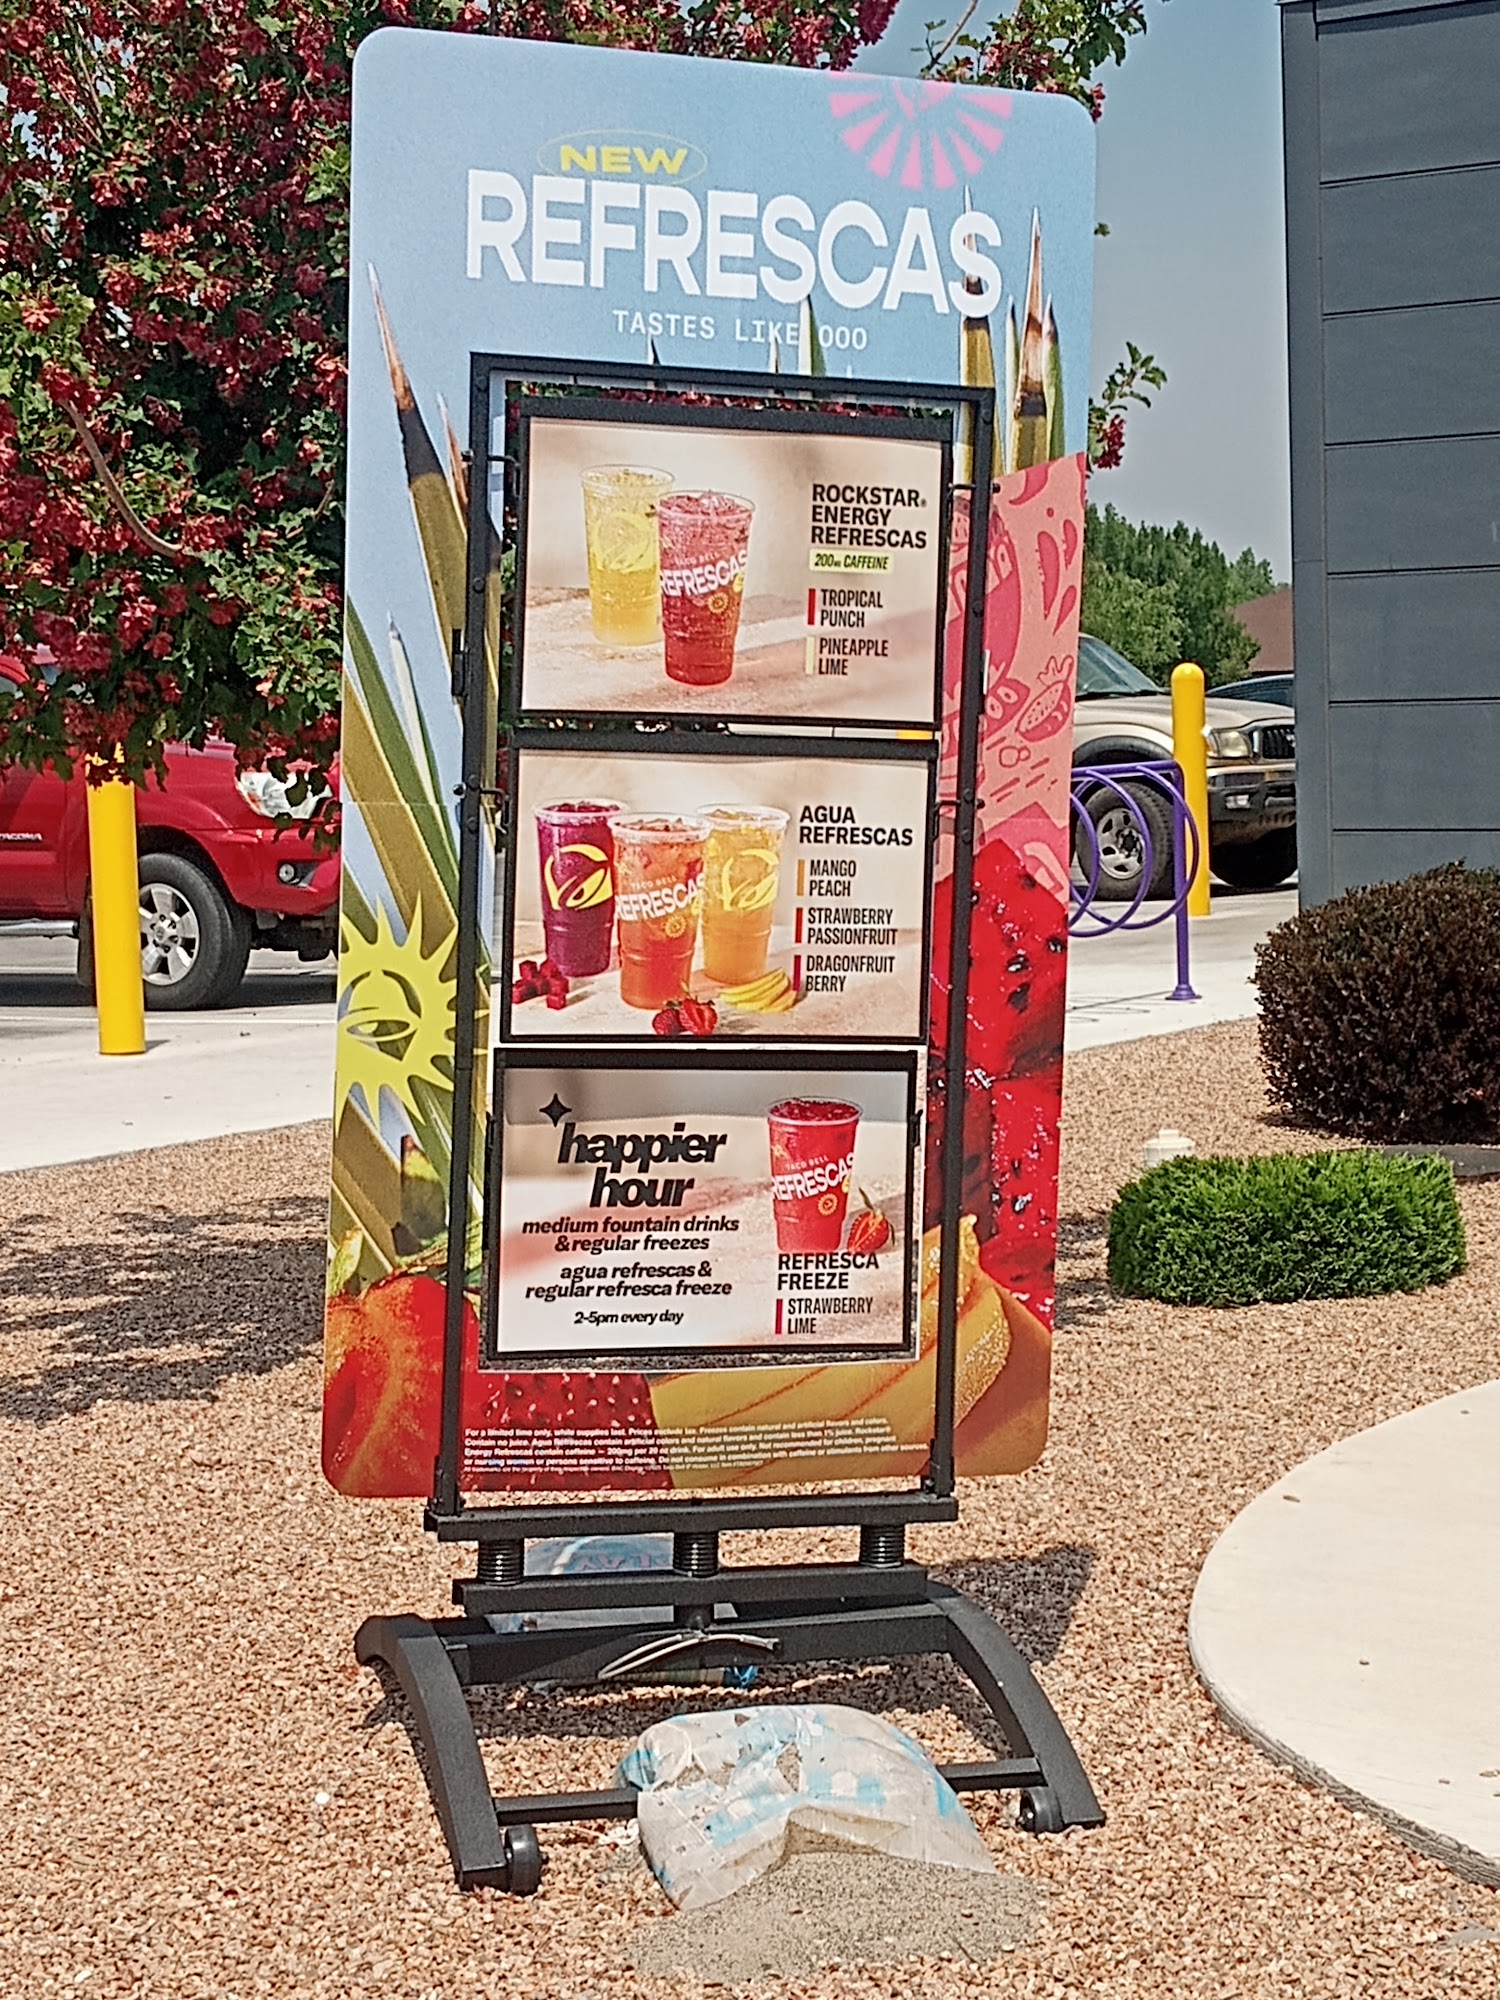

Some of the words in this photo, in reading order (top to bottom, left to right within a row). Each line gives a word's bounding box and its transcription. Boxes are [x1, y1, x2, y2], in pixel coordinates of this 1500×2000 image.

[560, 144, 689, 176] NEW
[466, 169, 1003, 318] REFRESCAS
[613, 310, 715, 340] TASTES
[734, 319, 799, 346] LIKE
[812, 506, 891, 527] ENERGY
[811, 527, 927, 549] REFRESCAS
[844, 555, 889, 570] CAFFEINE
[822, 589, 883, 609] TROPICAL
[821, 610, 865, 628] PUNCH
[819, 638, 888, 657] PINEAPPLE
[819, 659, 848, 676] LIME
[800, 805, 856, 824] AGUA
[800, 826, 913, 847] REFRESCAS
[810, 859, 856, 878] MANGO
[809, 880, 851, 897] PEACH
[808, 908, 893, 925] STRAWBERRY
[807, 928, 898, 946] PASSIONFRUIT
[806, 955, 896, 974] DRAGONFRUIT
[806, 975, 847, 993] BERRY
[558, 1123, 727, 1174] happier
[590, 1167, 695, 1208] hour
[522, 1218, 598, 1234] medium
[602, 1216, 680, 1233] fountain
[683, 1216, 739, 1232] drinks
[644, 1236, 710, 1251] freezes
[779, 1253, 880, 1270] REFRESCA
[560, 1266, 608, 1282] agua
[611, 1263, 696, 1279] refrescas
[698, 1261, 712, 1277] &
[526, 1280, 593, 1302] regular
[596, 1281, 672, 1297] refresca
[676, 1281, 733, 1296] freeze
[778, 1273, 849, 1291] FREEZE
[788, 1298, 873, 1315] STRAWBERRY
[574, 1312, 619, 1326] 2-5pm
[621, 1313, 657, 1326] every
[660, 1310, 684, 1325] day
[788, 1318, 816, 1334] LIME
[465, 1428, 479, 1437] For
[628, 1428, 653, 1436] Prices
[464, 1448, 493, 1457] Energy
[634, 1448, 647, 1456] per
[693, 1445, 706, 1453] For
[531, 1438, 552, 1447] Agua
